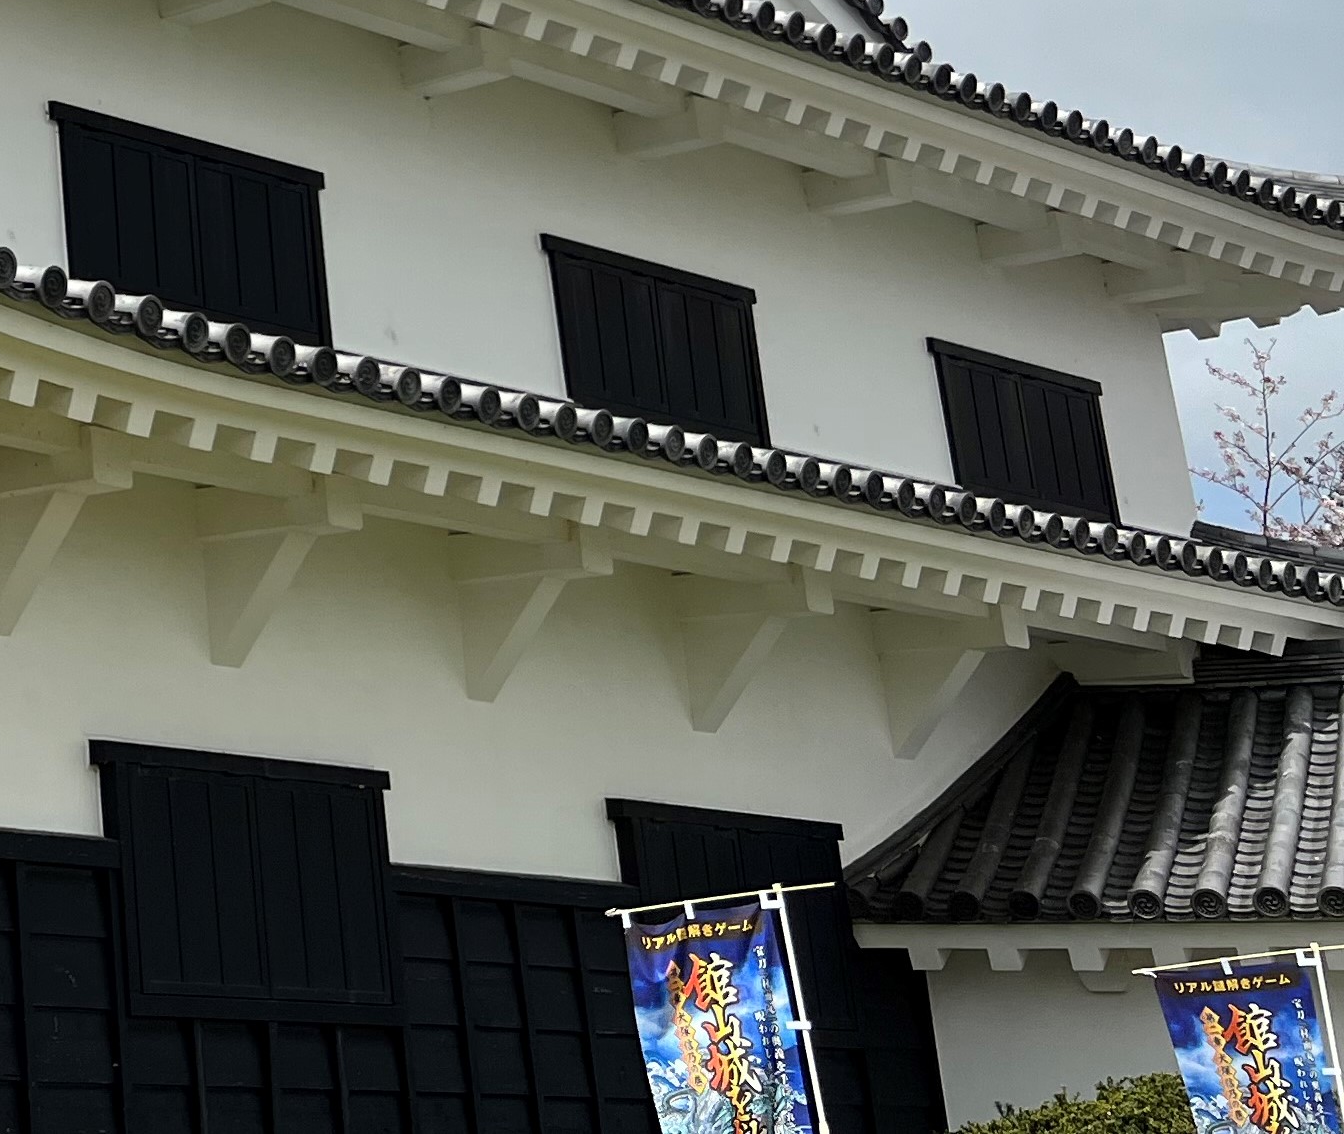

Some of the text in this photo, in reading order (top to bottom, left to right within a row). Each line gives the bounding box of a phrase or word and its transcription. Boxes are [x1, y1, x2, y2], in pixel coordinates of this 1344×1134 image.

[641, 919, 753, 950] リアル謎解きゲーム
[1173, 973, 1291, 994] リアル謎解きゲーム
